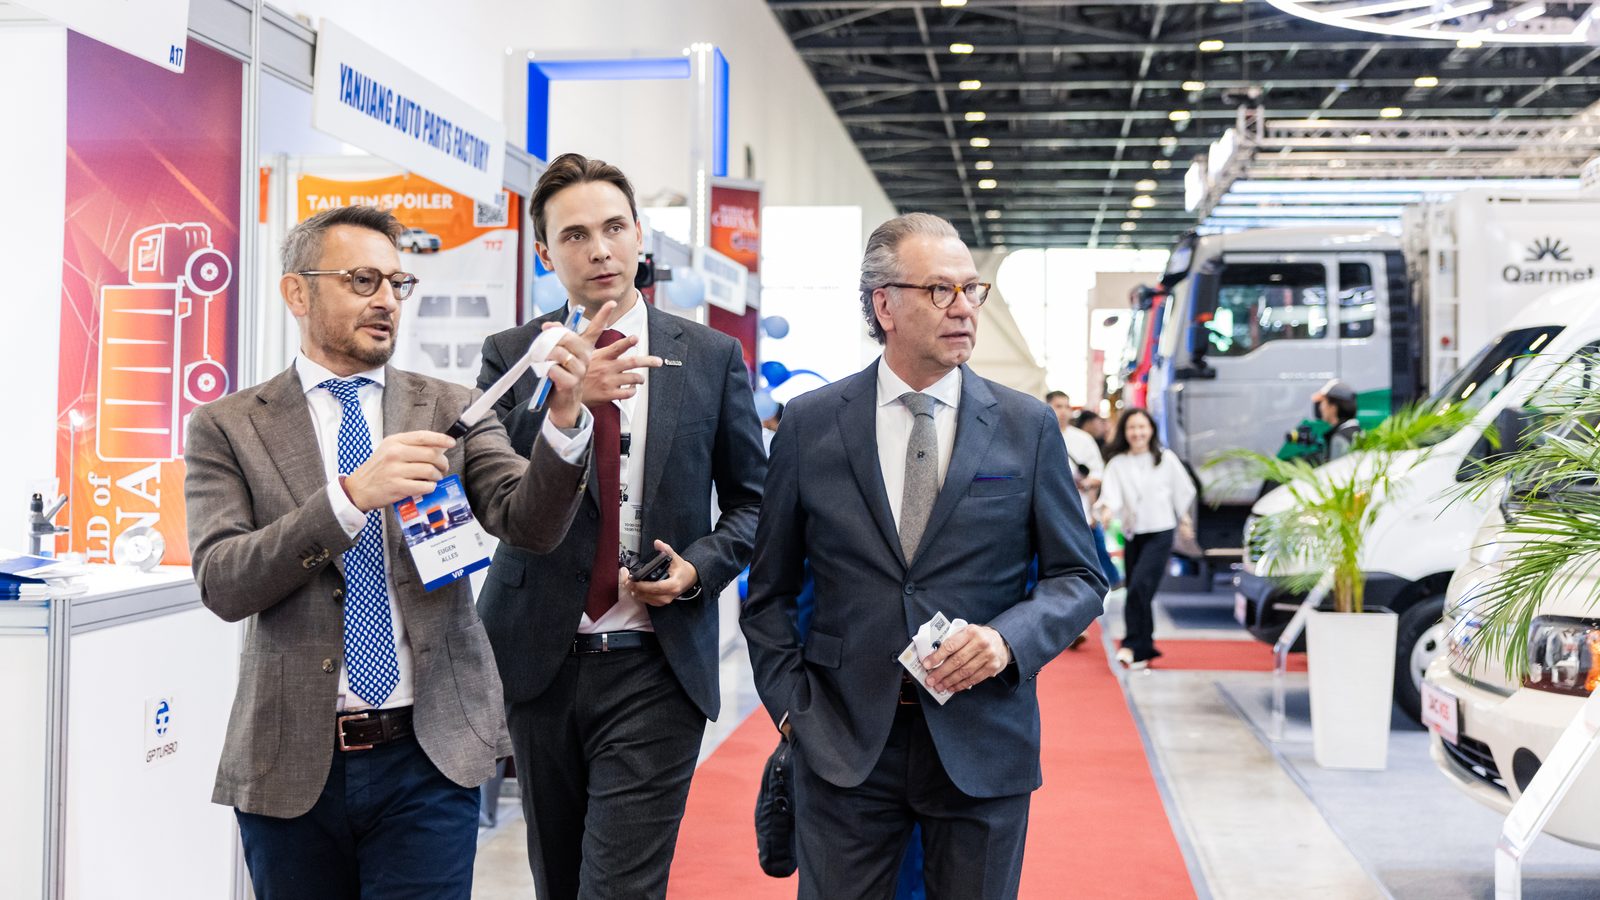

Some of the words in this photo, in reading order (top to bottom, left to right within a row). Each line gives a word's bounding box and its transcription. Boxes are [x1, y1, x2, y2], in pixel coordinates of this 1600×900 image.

[169, 45, 183, 67] A17
[339, 62, 393, 125] YANJIANG
[394, 94, 422, 139] AUTO
[423, 109, 452, 155] PARTS
[453, 125, 490, 173] FACTORY
[307, 195, 343, 209] TAIL
[87, 471, 112, 507] of
[86, 515, 112, 564] LD
[438, 544, 456, 556] EUGEN
[441, 552, 458, 563] ALLES
[452, 569, 464, 579] VIP
